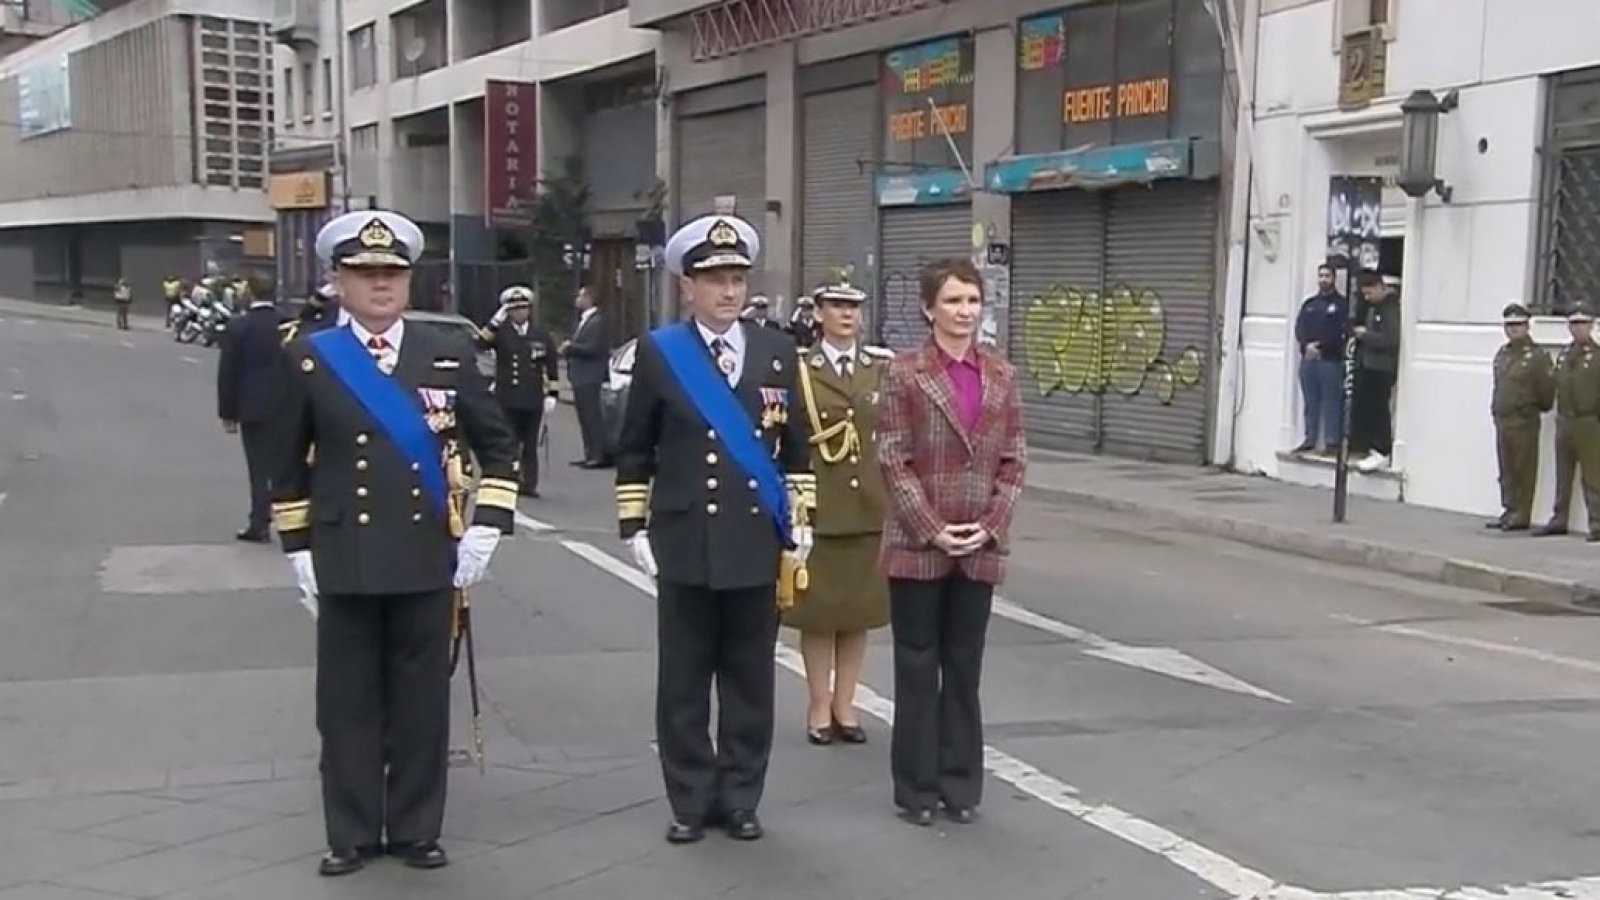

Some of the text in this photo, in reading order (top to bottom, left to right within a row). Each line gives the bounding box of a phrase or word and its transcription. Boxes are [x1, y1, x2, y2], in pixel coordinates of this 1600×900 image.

[1063, 78, 1169, 122] FUENTE PANCHO
[505, 84, 519, 208] NOTARIA
